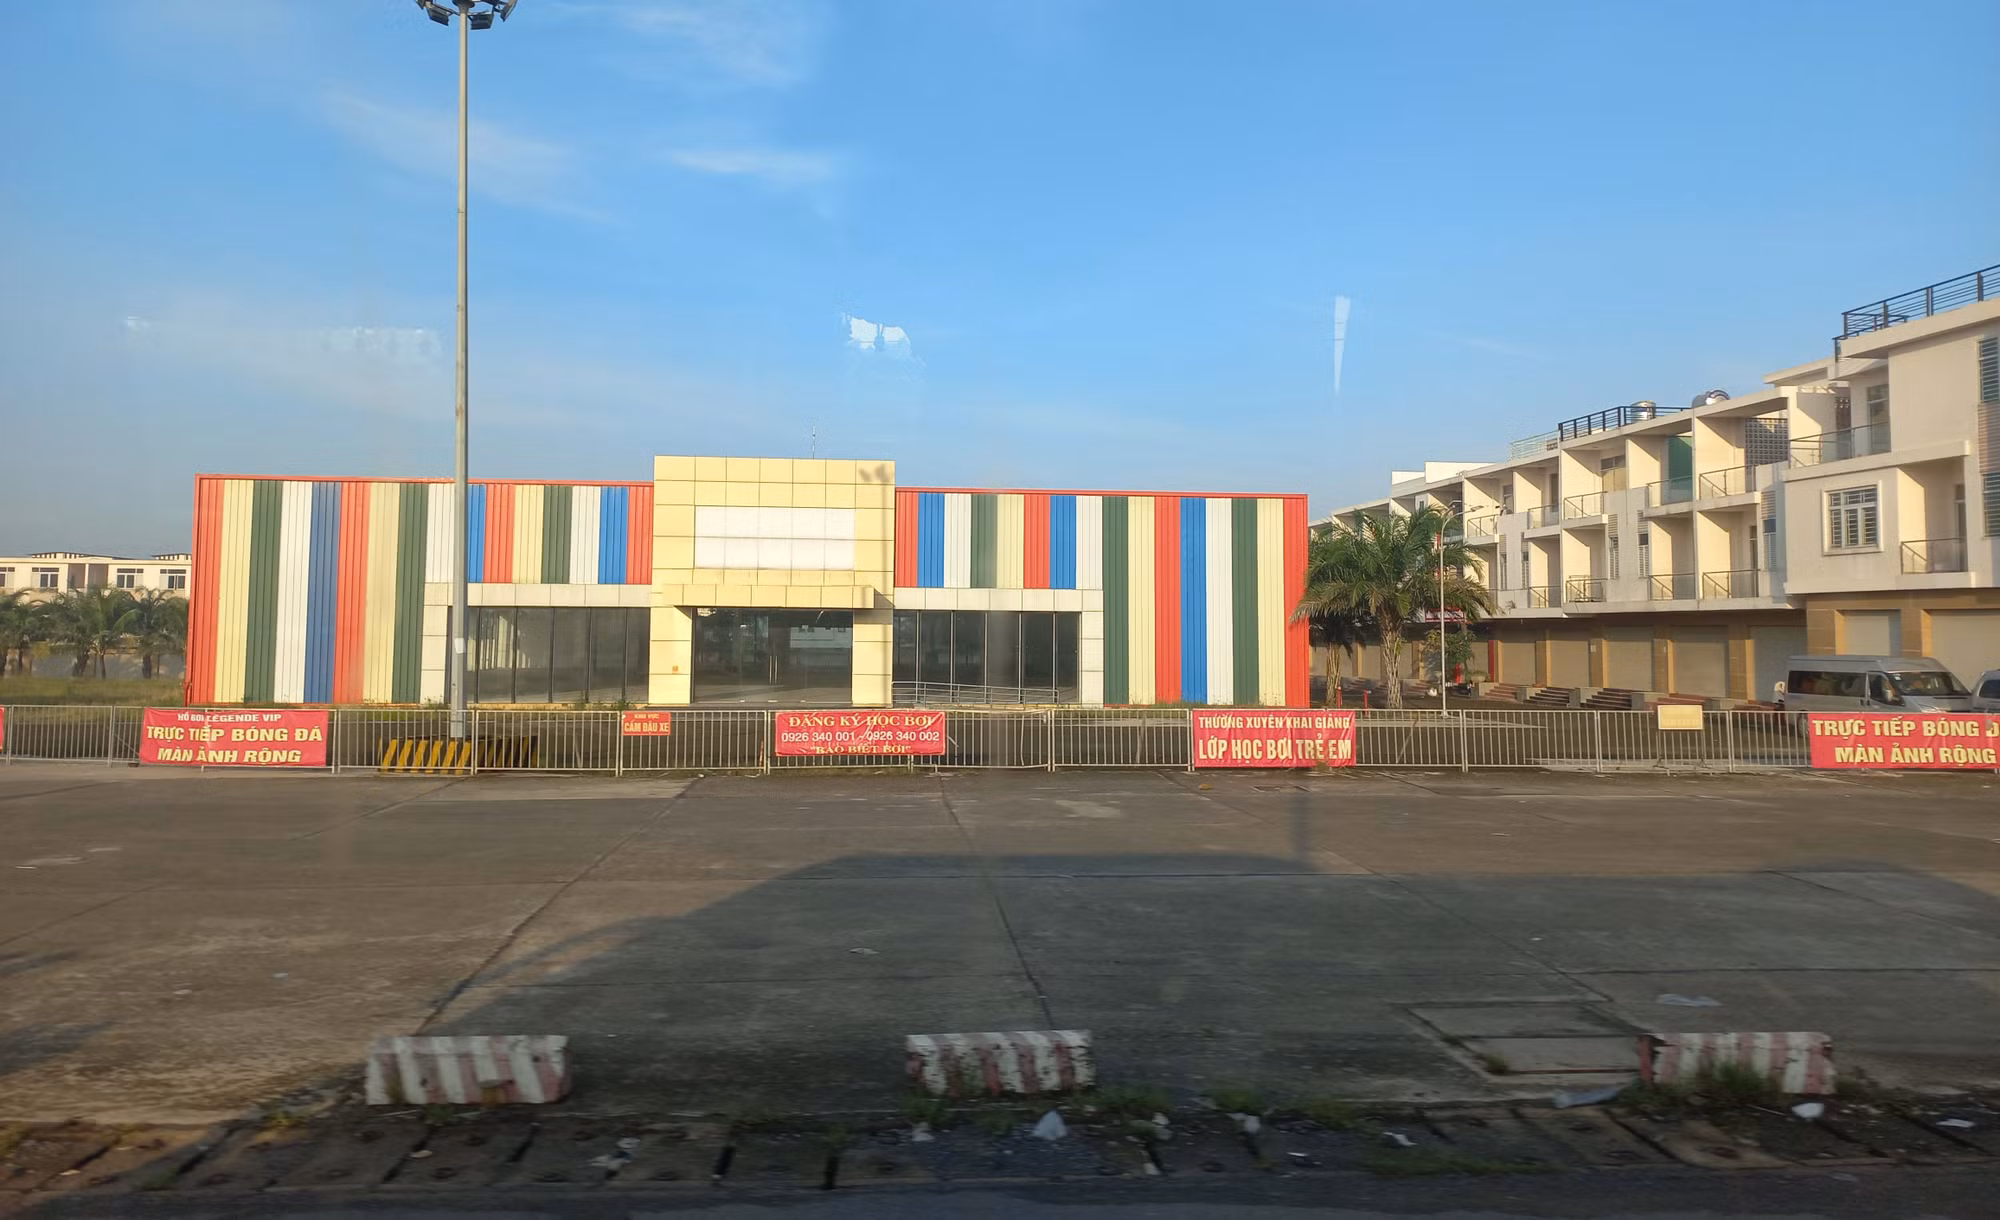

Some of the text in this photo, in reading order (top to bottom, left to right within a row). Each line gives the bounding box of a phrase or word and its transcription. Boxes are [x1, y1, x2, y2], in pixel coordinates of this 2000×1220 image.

[262, 714, 282, 722] VIP
[790, 714, 835, 727] ĐĂNG
[840, 713, 862, 727] KÝ
[866, 716, 900, 728] HỌC
[1246, 714, 1283, 728] XUYÊN
[1286, 716, 1312, 728] KHAI
[146, 724, 323, 742] TRỰC TIẾP BÓNG ĐÁ
[659, 722, 669, 732] XE
[1812, 719, 1866, 739] TRỰC
[1872, 716, 1916, 736] TIẾP
[1922, 718, 1980, 737] BÓNG
[782, 732, 809, 742] 0926
[812, 732, 832, 742] 340
[835, 732, 855, 742] 001
[866, 731, 893, 741] 0926
[896, 731, 916, 741] 340
[919, 731, 940, 741] 002
[157, 746, 302, 765] MÀN ẢNH RỘNG
[1199, 733, 1352, 763] LỚP HỌC BƠI TRẺ EM
[1834, 743, 1997, 766] MÀN ẢNH RỘNG
